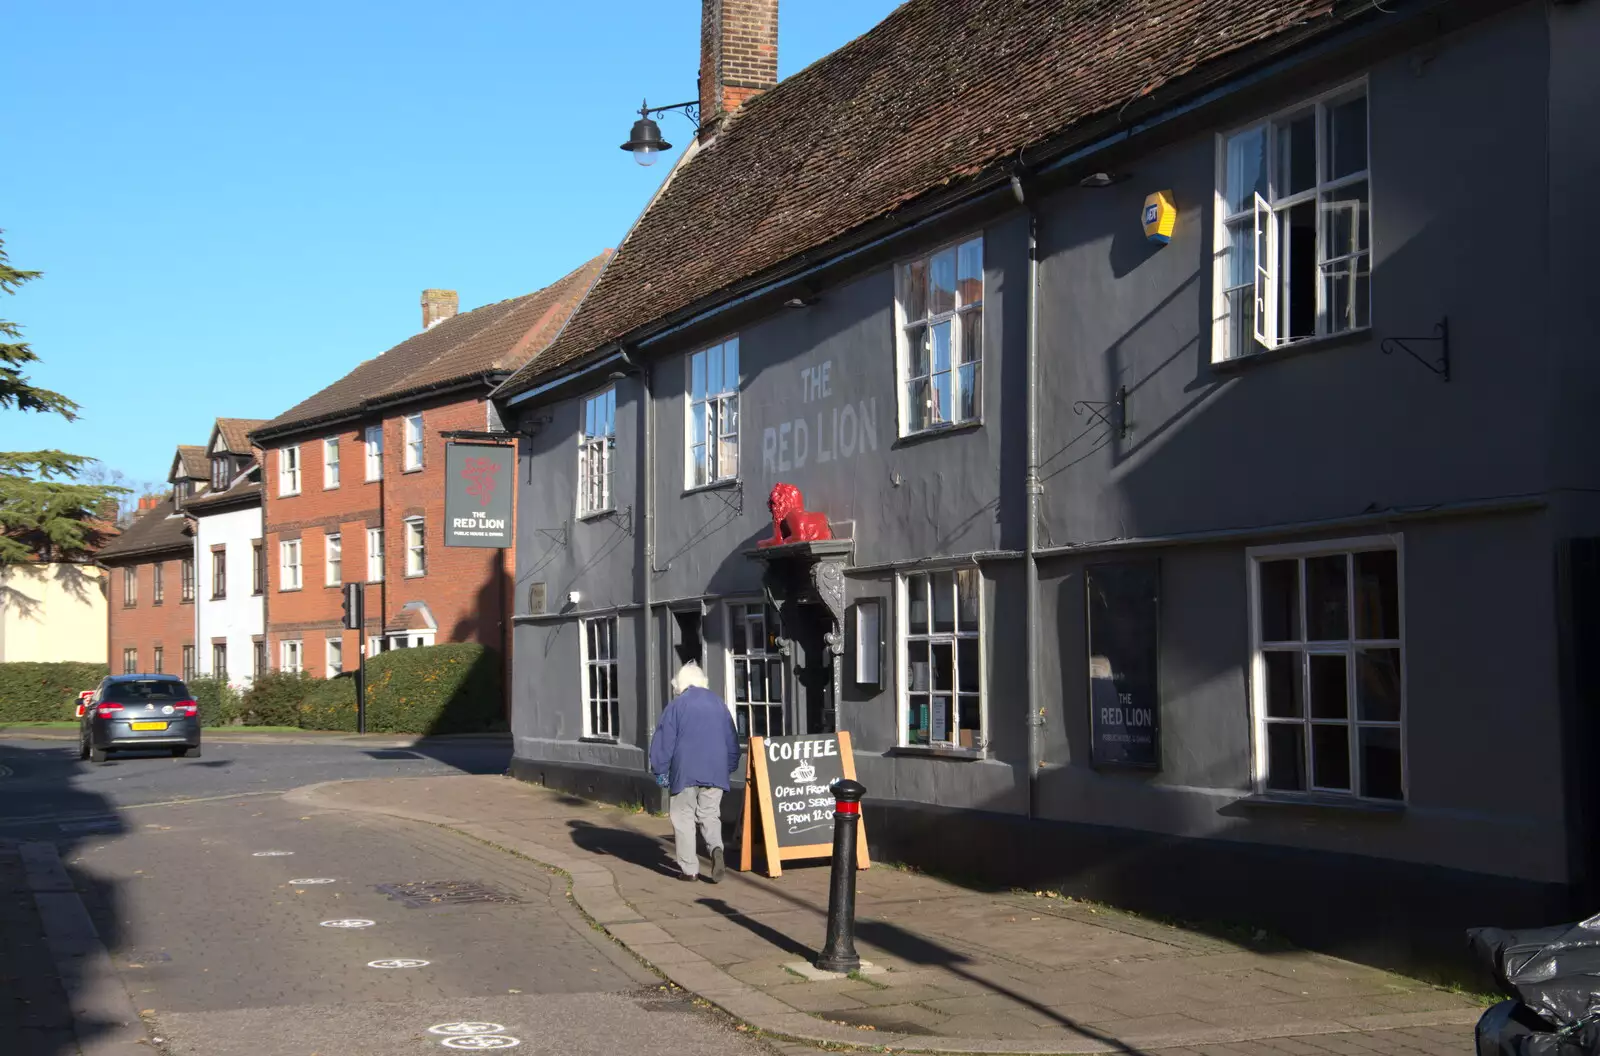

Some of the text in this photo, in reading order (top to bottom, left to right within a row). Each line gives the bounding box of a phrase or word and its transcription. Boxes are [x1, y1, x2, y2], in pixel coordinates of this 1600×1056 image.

[801, 360, 833, 403] THE
[763, 397, 878, 474] RED LION
[453, 518, 504, 529] RED LION
[1118, 692, 1132, 704] THE
[1102, 708, 1152, 726] RED LION
[769, 739, 837, 762] COFFEE
[776, 786, 804, 798] OPEN
[806, 785, 830, 796] FROM
[778, 797, 836, 814] FOOD SERVE
[786, 814, 810, 824] FROM
